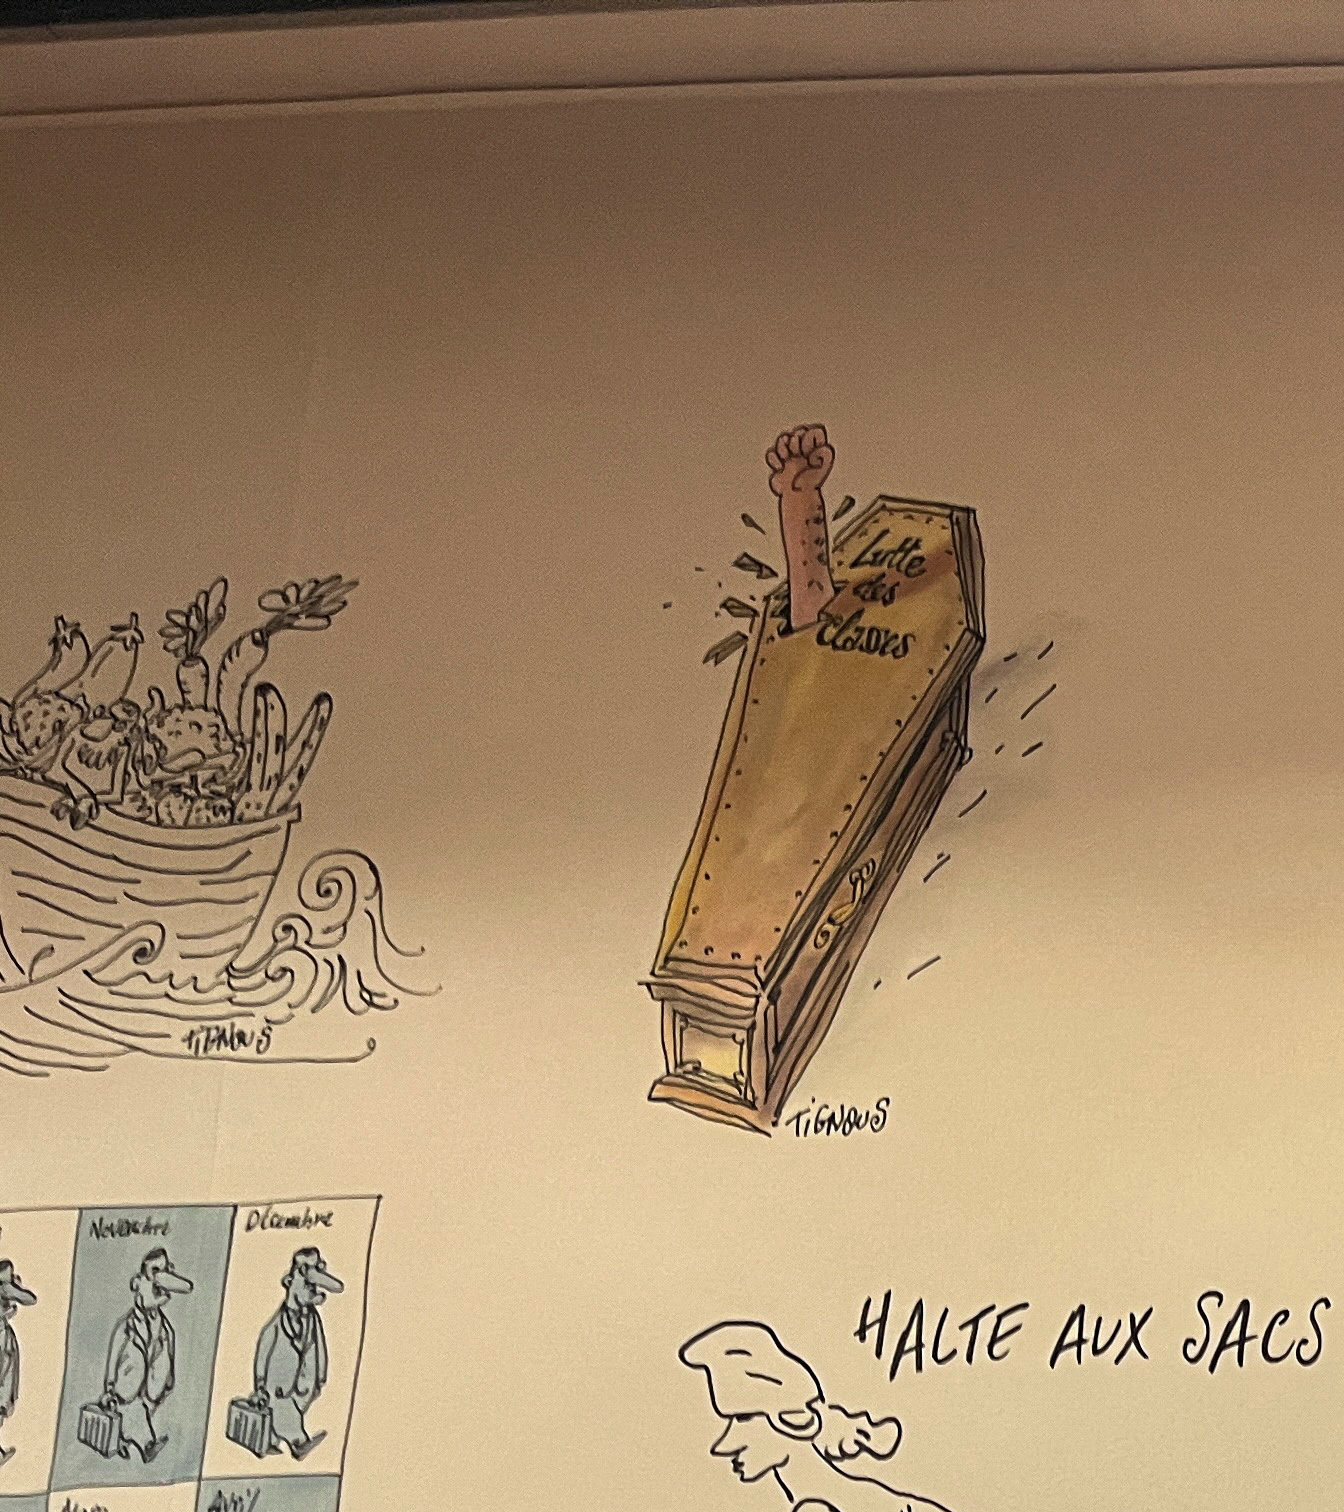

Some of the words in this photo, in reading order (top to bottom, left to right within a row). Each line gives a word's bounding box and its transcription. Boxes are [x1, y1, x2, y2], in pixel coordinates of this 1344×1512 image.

[849, 527, 928, 579] Lutte
[852, 1287, 1030, 1381] HALTE
[1050, 1302, 1156, 1366] AUX
[1183, 1290, 1333, 1373] SACS
